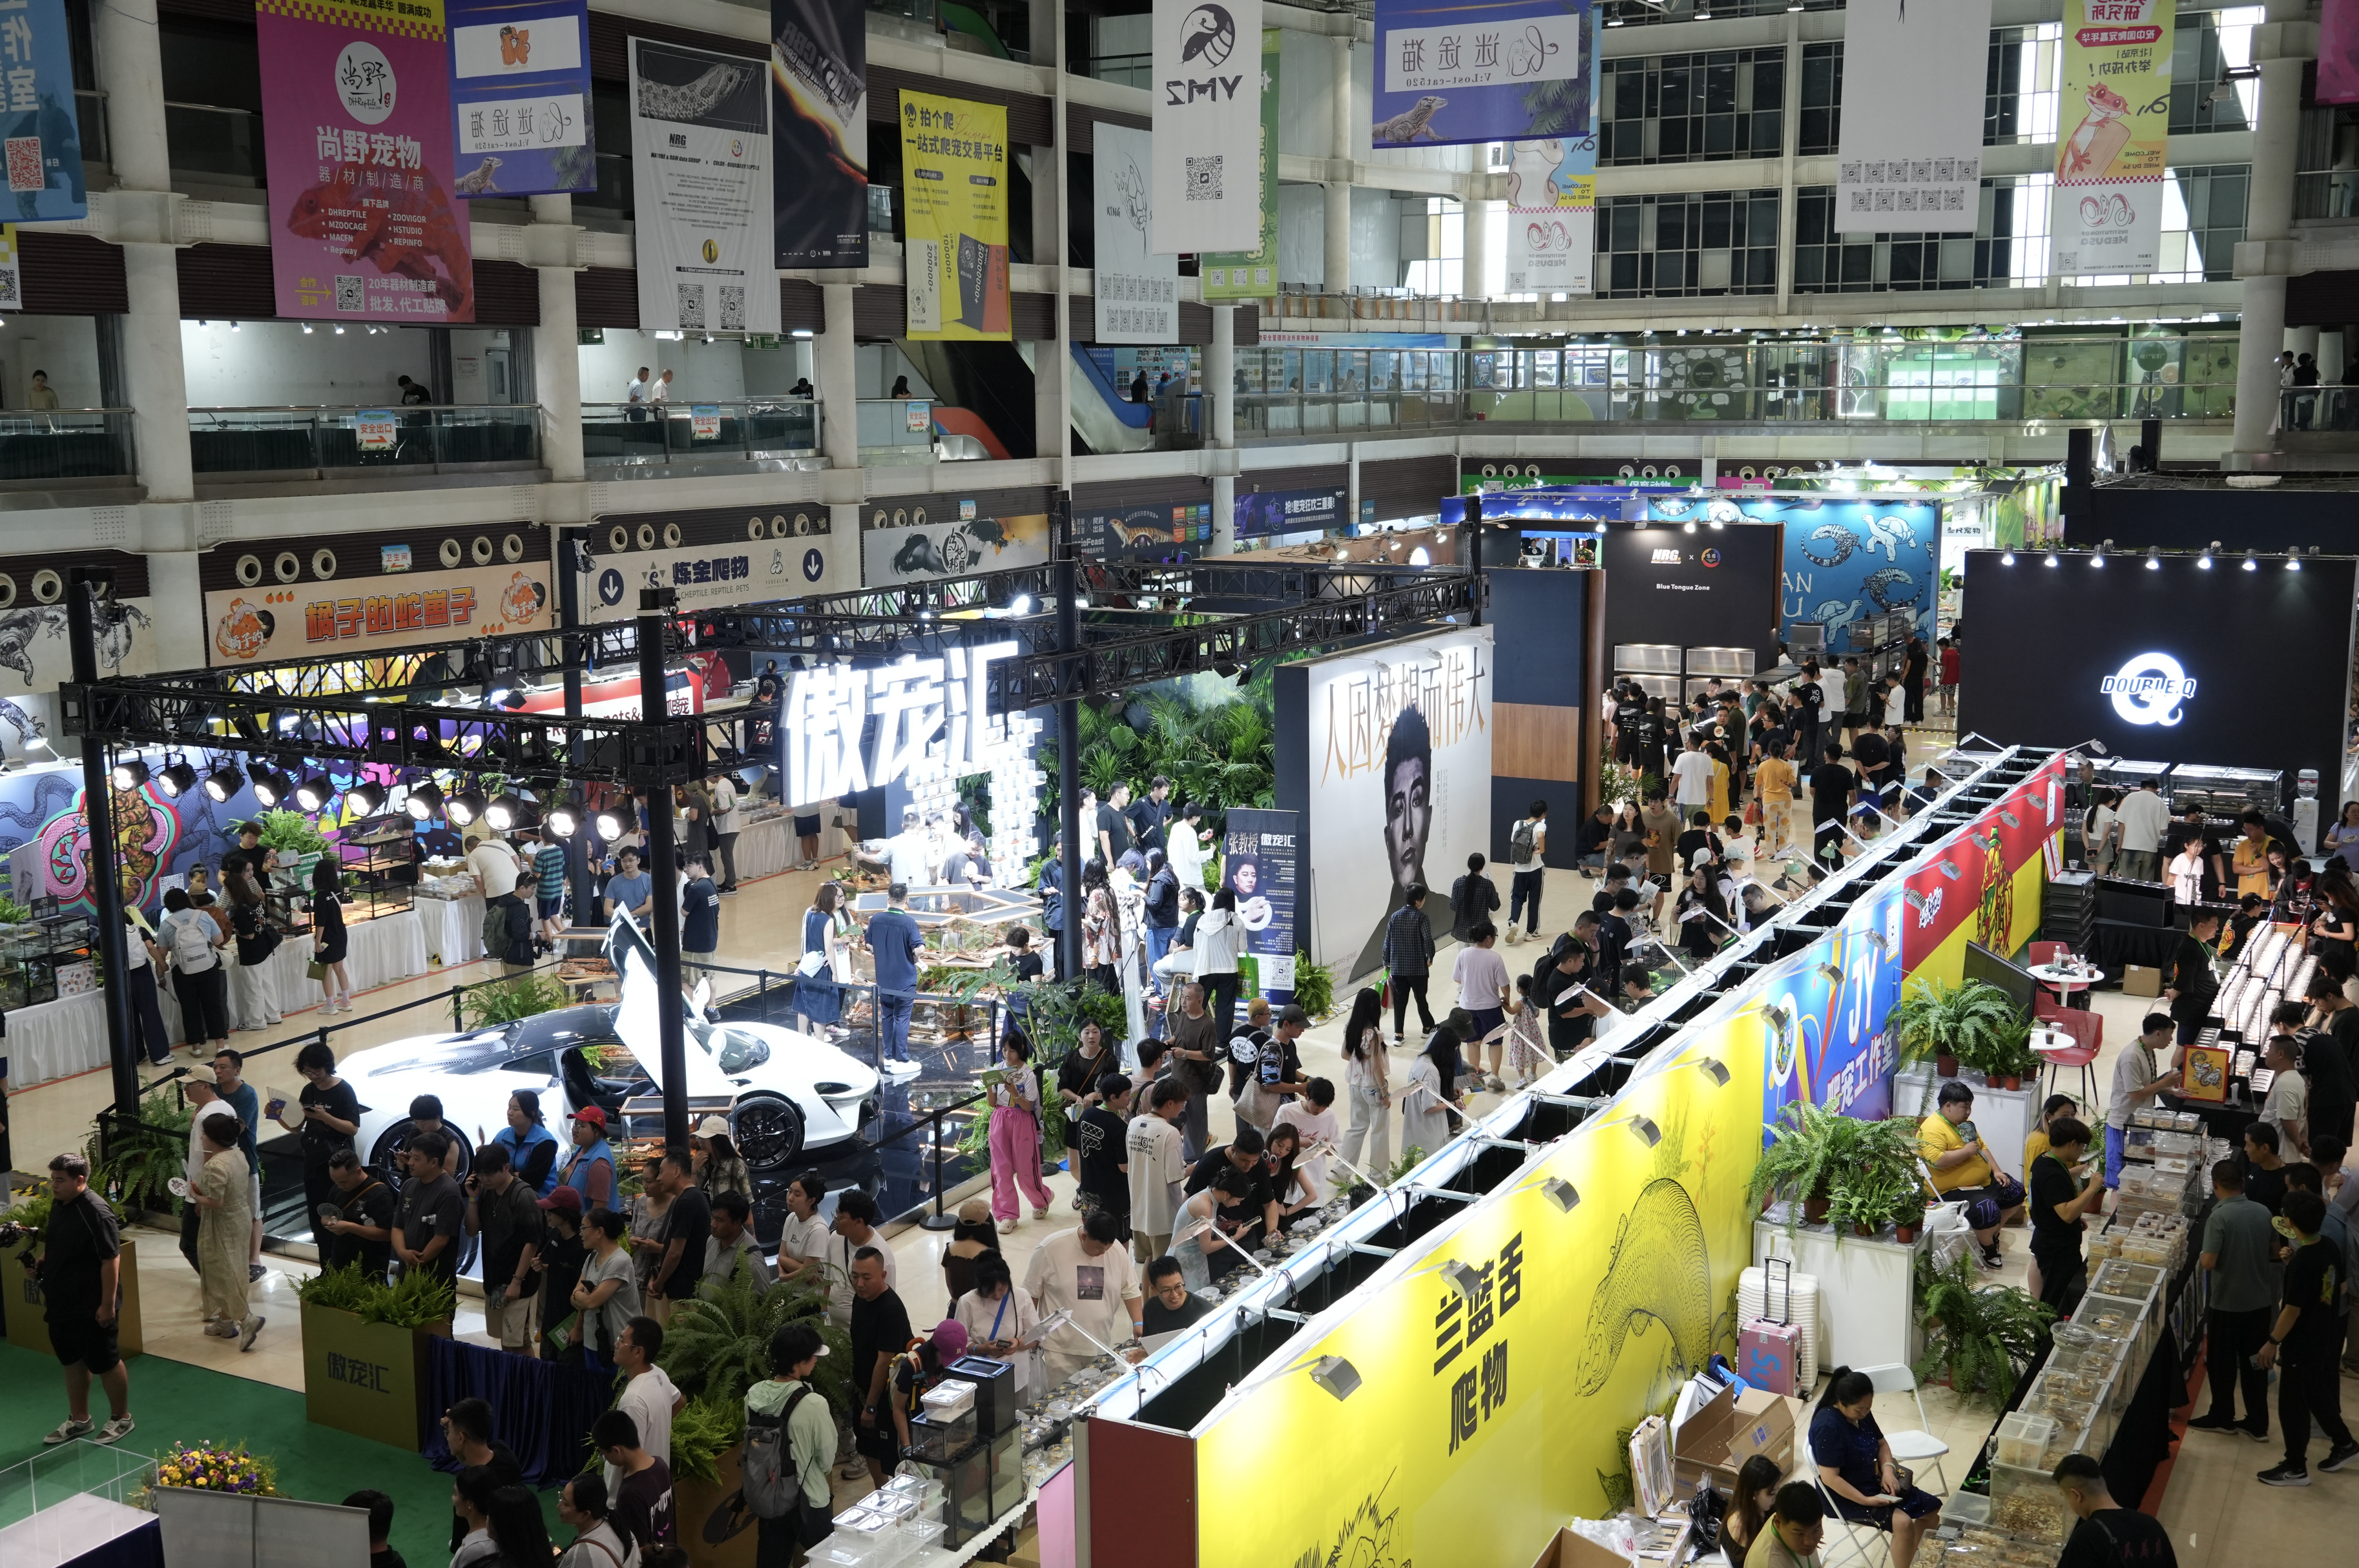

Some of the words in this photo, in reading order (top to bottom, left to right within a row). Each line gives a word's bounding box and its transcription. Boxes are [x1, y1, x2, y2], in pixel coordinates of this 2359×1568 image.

[398, 3, 431, 18] 圆满成功
[920, 107, 953, 130] 拍个爬
[669, 133, 687, 146] NRG
[317, 125, 421, 170] 尚野宠物
[906, 134, 1003, 162] 一站式爬宠交易平台
[362, 198, 390, 209] 旗下品牌
[328, 208, 367, 218] DHREPTILE
[1107, 206, 1120, 218] KING
[393, 214, 426, 223] ZOOVIGOR
[329, 221, 368, 231] MZOOCAGE
[393, 226, 422, 235] HSTUDIO
[329, 233, 353, 242] MACFN
[394, 238, 422, 247] REPINFO
[330, 245, 357, 256] Repway
[300, 278, 317, 288] 合作
[368, 278, 437, 293] 20年器材制造商
[301, 295, 317, 306] 咨询
[369, 296, 446, 314] 批发、代工贴牌
[694, 417, 717, 425] 安全出口
[360, 423, 392, 433] 安全出口
[386, 553, 408, 562] 卫生间
[672, 555, 749, 586] 炼金爬物
[711, 586, 733, 596] REPTILE
[736, 584, 749, 592] PETS
[304, 585, 477, 642] 橘子的蛇崽子
[780, 641, 1017, 807] 傲宠汇
[1229, 832, 1258, 856] 张教授
[1261, 833, 1296, 847] 傲宠汇
[187, 953, 207, 962] SKECHERS
[1346, 950, 1356, 962] great
[1336, 965, 1352, 977] dreams
[1848, 947, 1879, 1046] JY
[327, 1351, 390, 1394] 傲宠汇
[1449, 1339, 1508, 1457] 爬物
[1676, 1477, 1693, 1487] Haier
